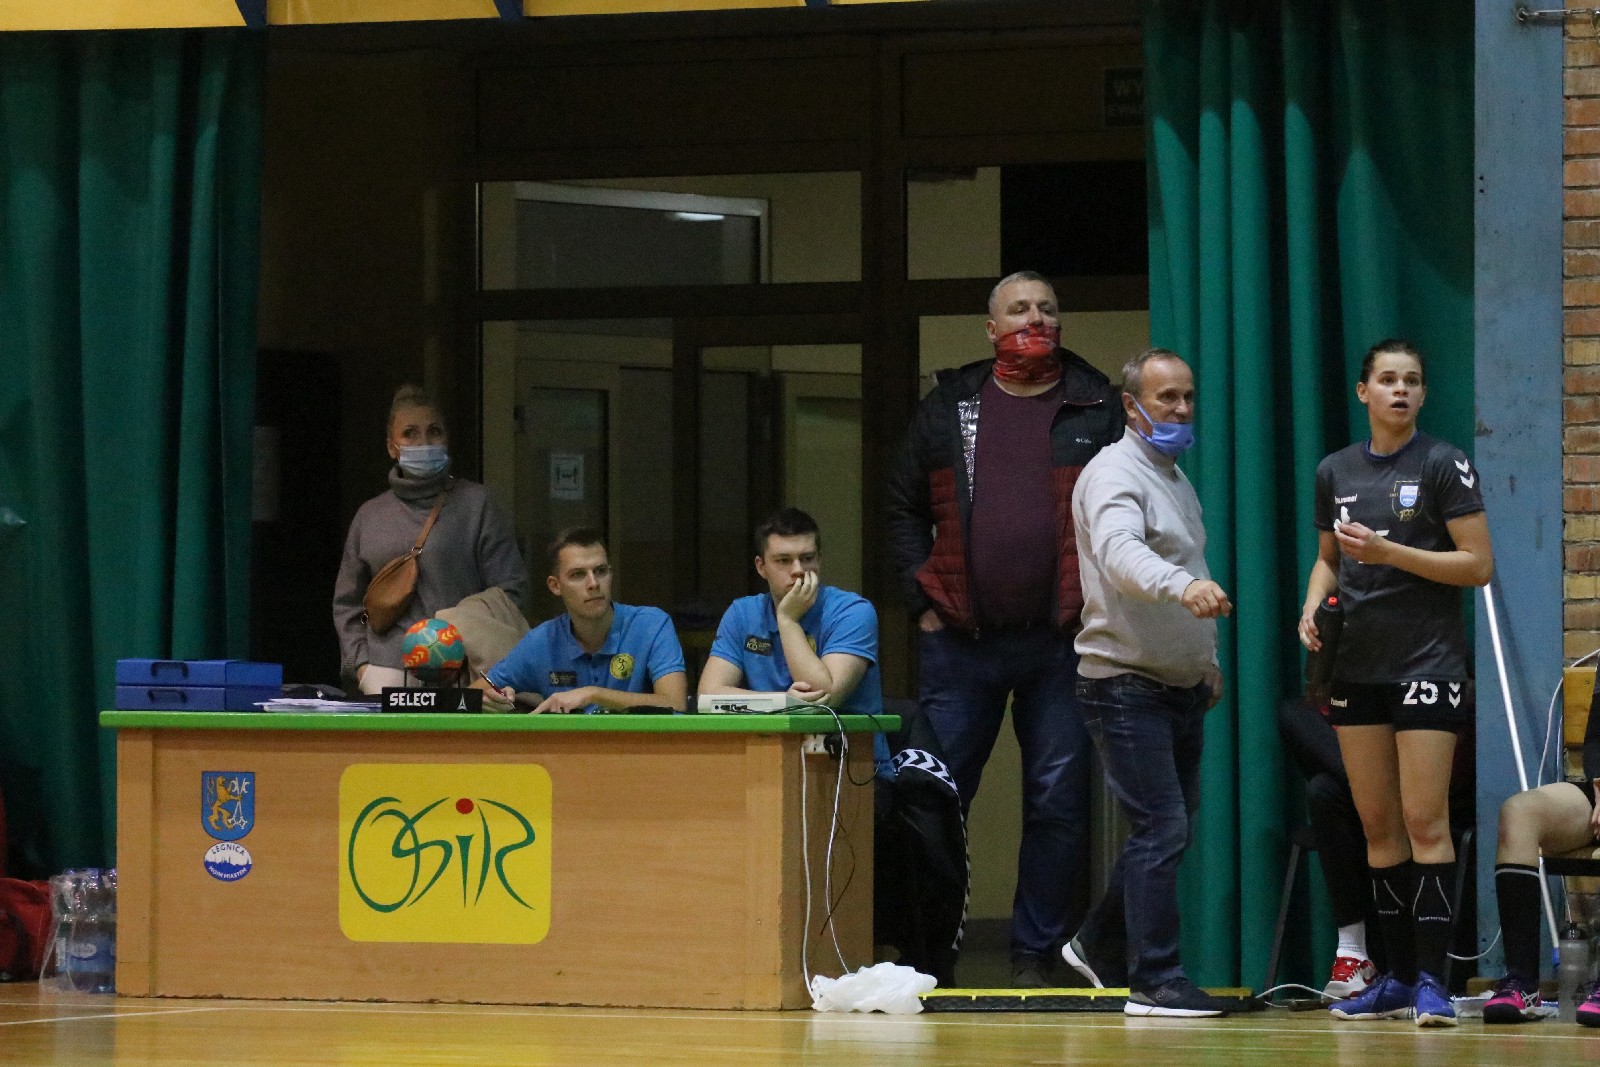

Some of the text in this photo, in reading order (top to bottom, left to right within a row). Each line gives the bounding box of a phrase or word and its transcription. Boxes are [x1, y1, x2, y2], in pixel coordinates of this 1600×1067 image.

[389, 692, 436, 707] SELECT
[1401, 681, 1439, 705] 25
[211, 844, 245, 856] LEGNICA
